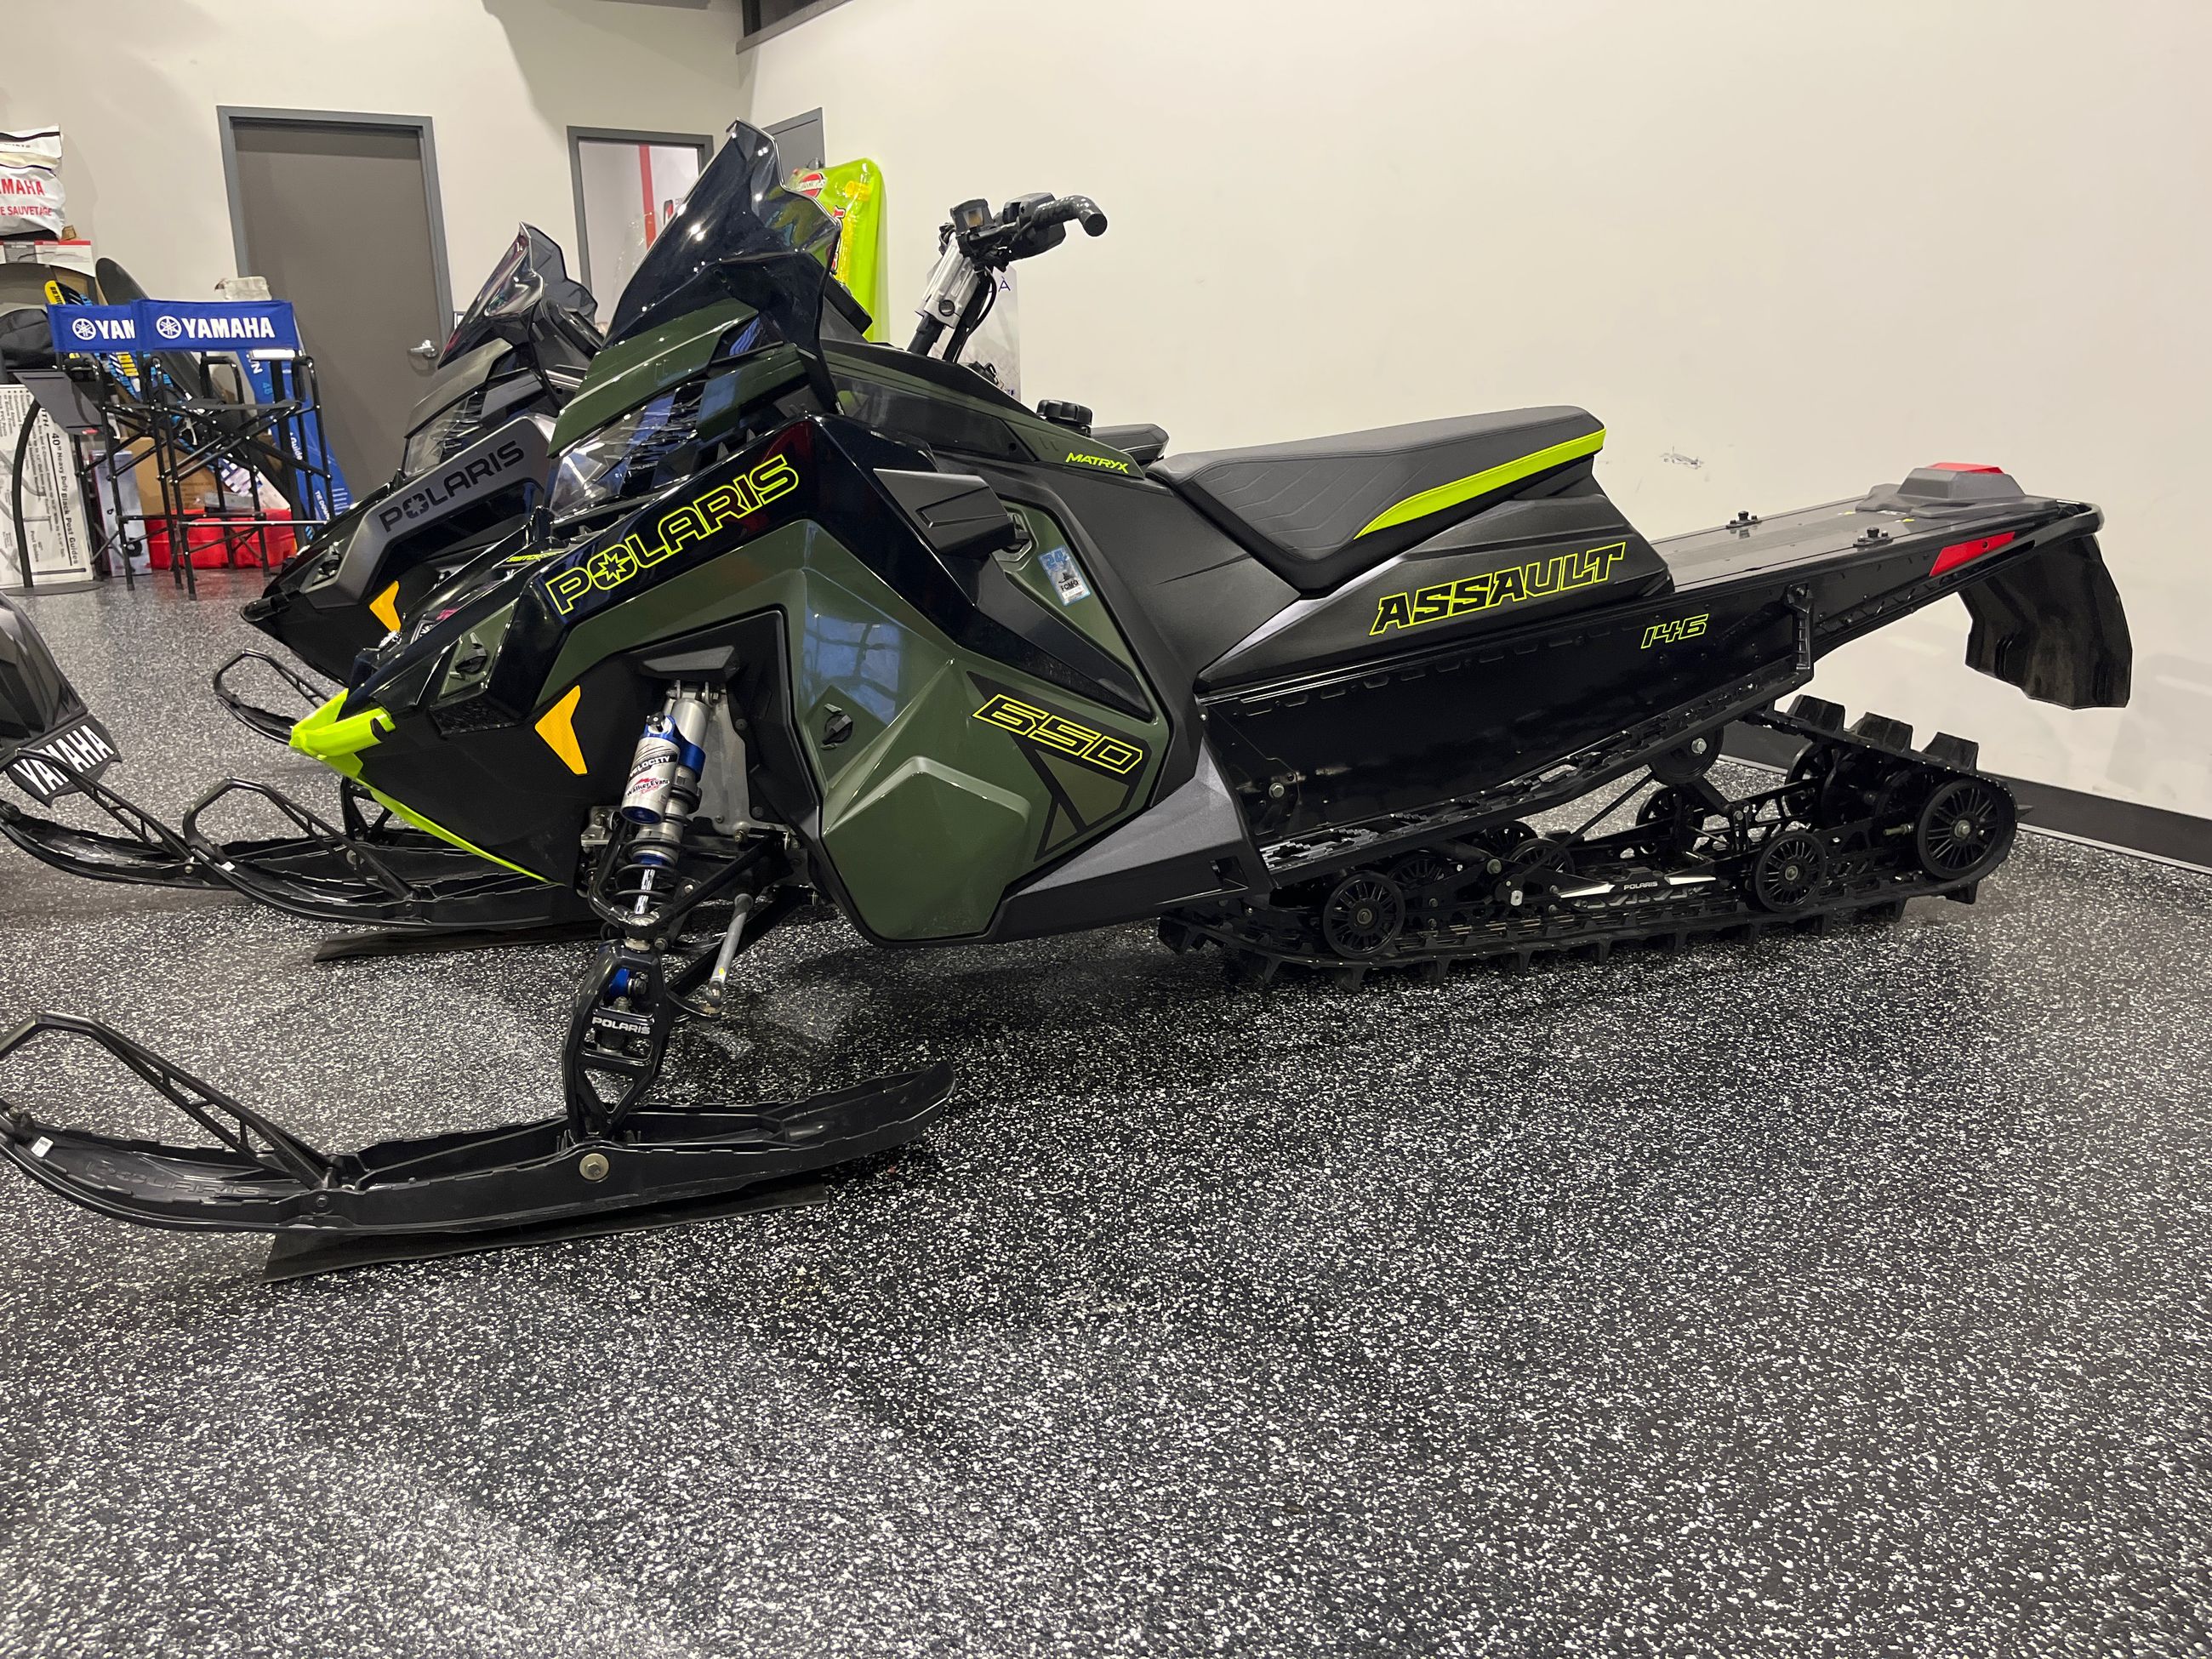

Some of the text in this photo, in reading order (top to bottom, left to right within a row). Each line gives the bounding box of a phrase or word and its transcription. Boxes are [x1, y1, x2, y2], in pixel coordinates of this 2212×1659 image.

[0, 179, 45, 196] MAHA
[8, 206, 52, 216] SAUVETAGE
[181, 317, 276, 339] YAMAHA
[55, 452, 66, 474] Heavy
[1066, 452, 1130, 474] MATRYX
[60, 476, 69, 493] Duty
[379, 439, 525, 533] POLARIS
[61, 493, 71, 515] Black
[66, 517, 74, 535] Post
[544, 453, 799, 615] POLARIS
[69, 537, 79, 564] Guides
[1369, 542, 1625, 636] ASSAULT
[1641, 613, 1708, 649] 146
[972, 693, 1143, 774] 650
[1623, 881, 1658, 890] POLARIS
[592, 1016, 651, 1035] POLARIS
